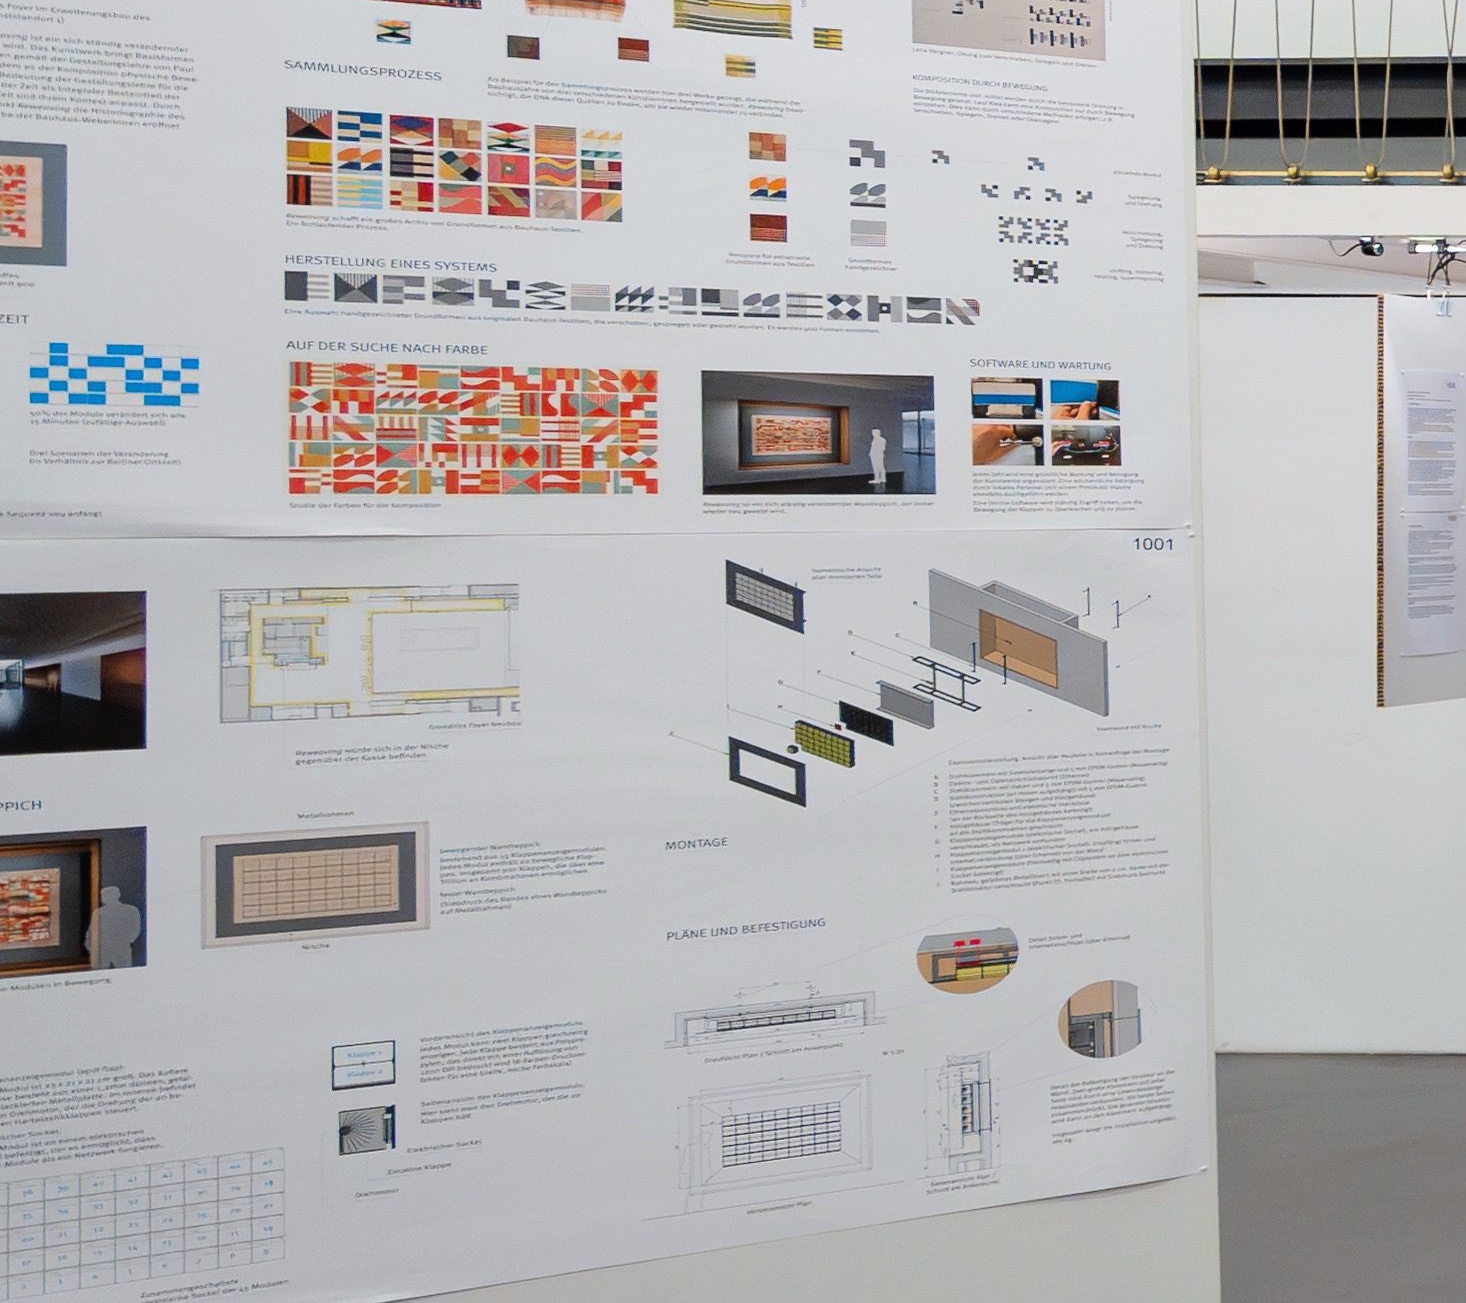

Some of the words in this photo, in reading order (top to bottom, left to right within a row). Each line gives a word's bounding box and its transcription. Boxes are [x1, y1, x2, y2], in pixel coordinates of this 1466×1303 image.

[284, 59, 442, 81] SAMMLUNGSPROZESS
[285, 254, 385, 268] HERSTELLUNG
[391, 258, 431, 270] EINES
[434, 260, 497, 273] SYSTEMS
[286, 340, 315, 351] AUF
[318, 340, 346, 352] DER
[350, 342, 399, 353] SUCHE
[402, 343, 441, 354] NACH
[446, 344, 489, 355] FARBE
[969, 358, 1028, 369] SOFTWARE
[1031, 360, 1055, 370] UND
[1057, 361, 1112, 371] WARTUNG
[1134, 537, 1173, 551] 1001
[665, 837, 728, 850] MONTAGE
[666, 927, 707, 941] PLÄNE
[710, 925, 738, 937] UND
[742, 917, 827, 934] BEFESTIGUNG
